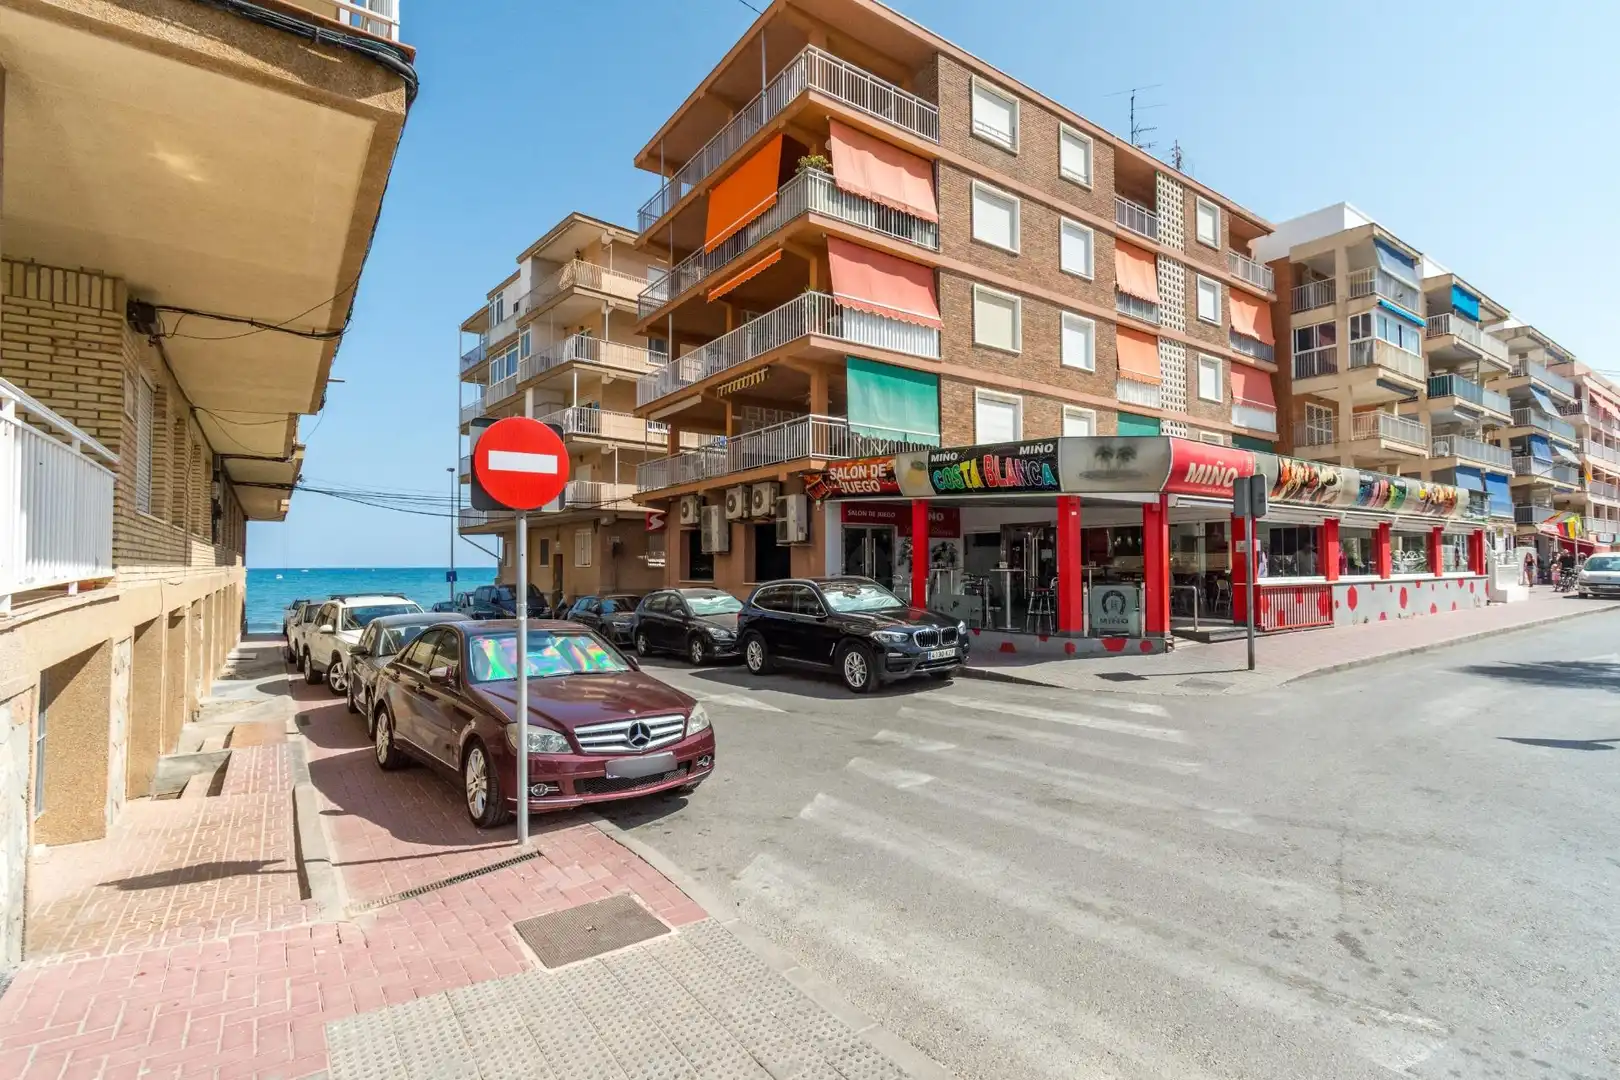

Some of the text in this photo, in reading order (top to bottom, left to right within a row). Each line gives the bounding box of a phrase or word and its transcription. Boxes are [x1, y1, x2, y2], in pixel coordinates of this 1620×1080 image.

[1019, 443, 1054, 455] MIÑO
[931, 451, 958, 462] MIÑO
[829, 464, 887, 481] SALON DE
[933, 454, 1058, 489] COSTA BLANCA
[1184, 461, 1238, 488] MIÑO
[841, 480, 880, 494] JUEGO
[877, 510, 896, 518] JUEGO
